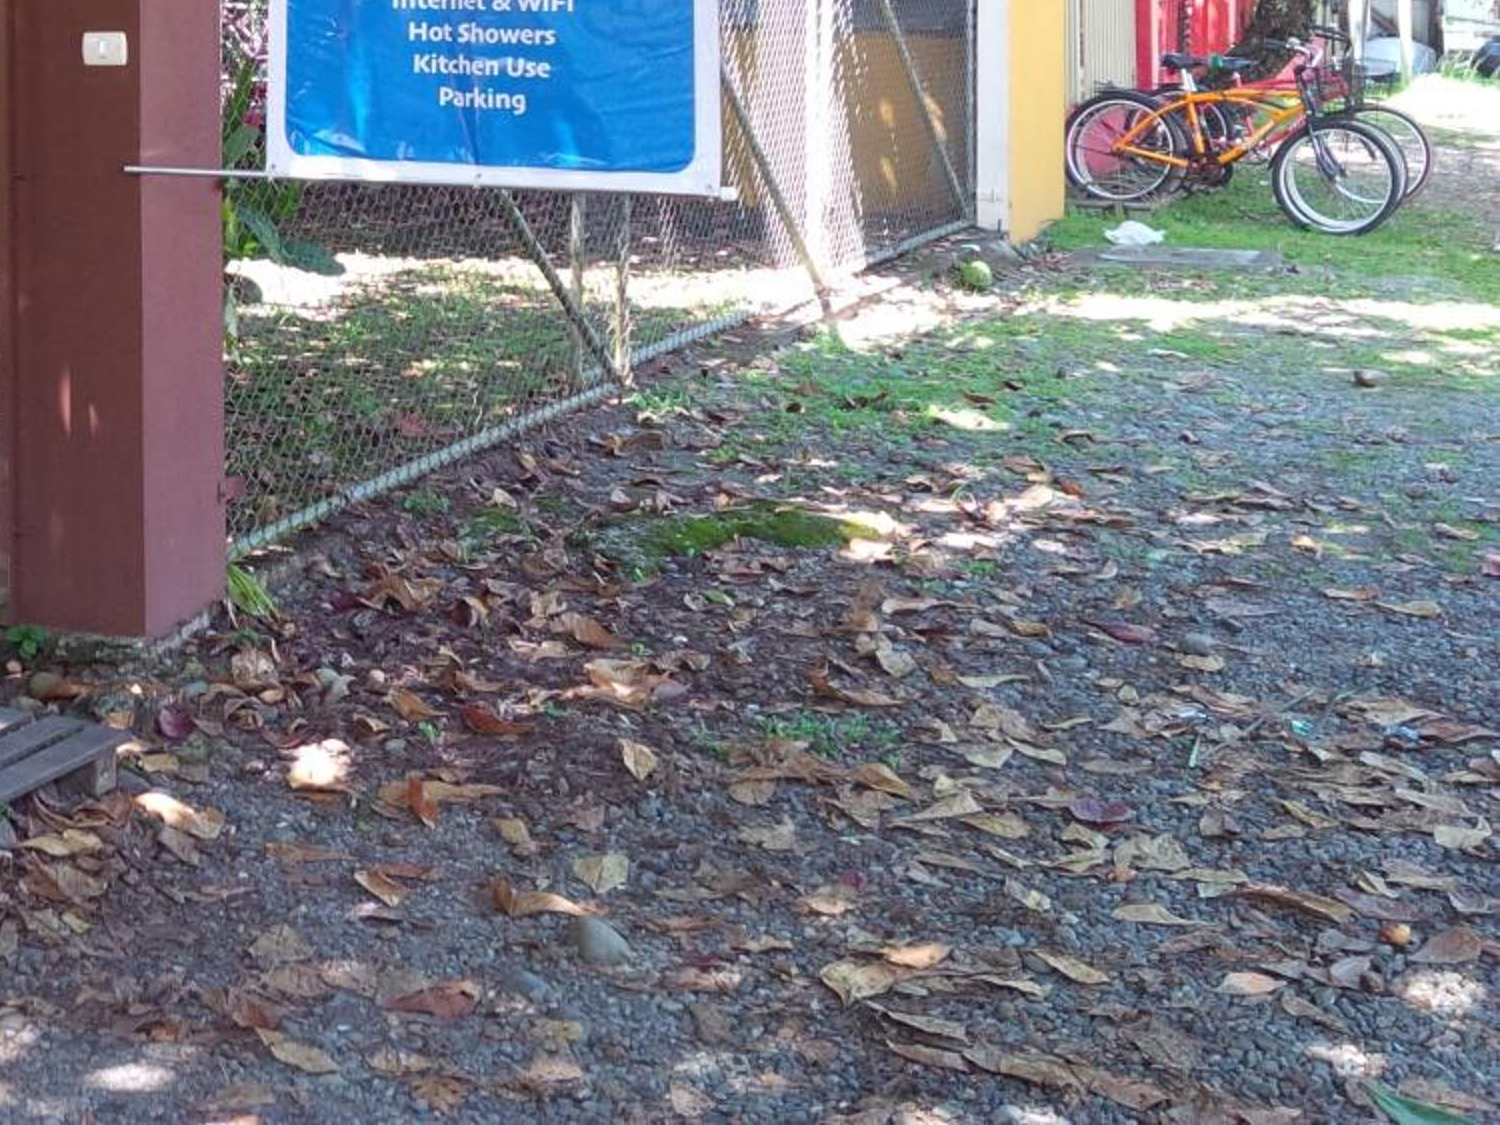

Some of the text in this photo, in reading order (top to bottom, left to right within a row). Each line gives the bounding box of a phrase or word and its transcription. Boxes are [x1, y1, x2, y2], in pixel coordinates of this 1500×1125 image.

[408, 21, 556, 46] Hot Showers
[412, 53, 551, 78] Kitchen Use
[439, 86, 527, 114] Parking
